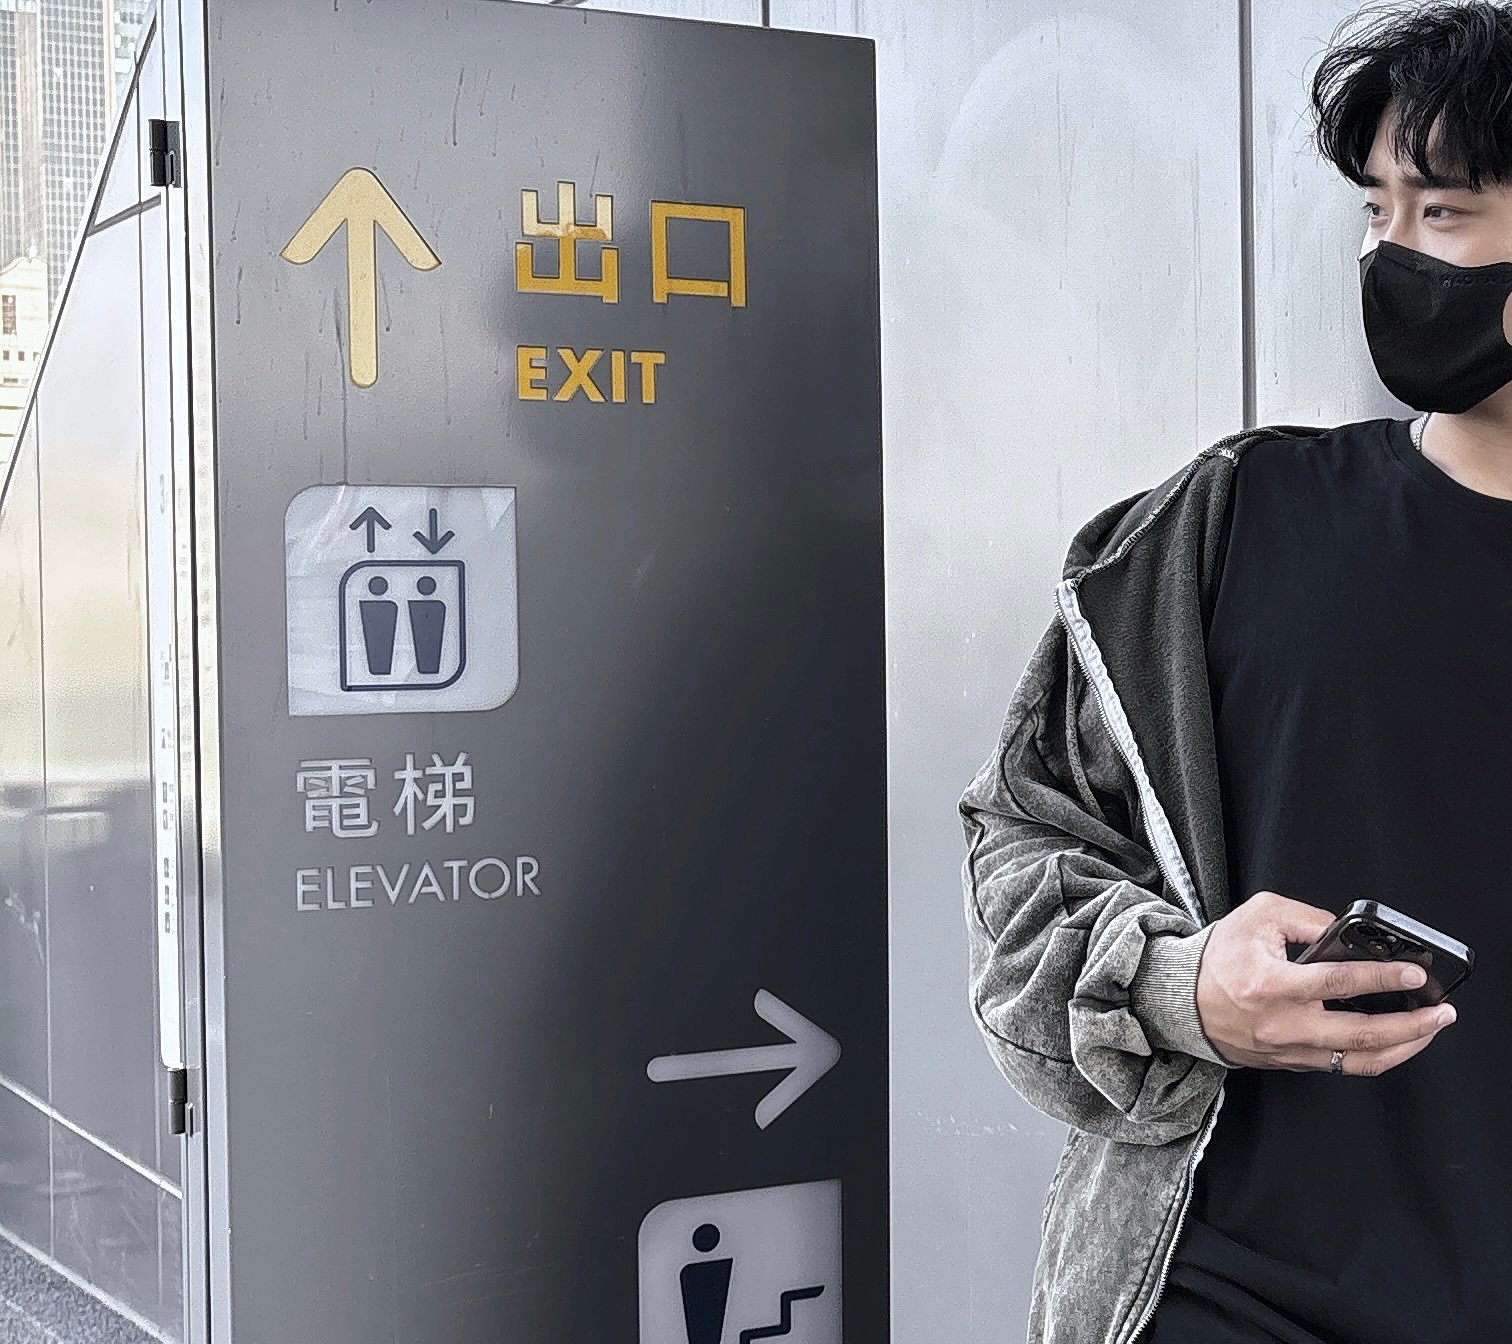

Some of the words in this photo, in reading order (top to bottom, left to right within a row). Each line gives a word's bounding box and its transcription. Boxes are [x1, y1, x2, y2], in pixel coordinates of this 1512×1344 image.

[515, 181, 747, 308] 出口
[516, 345, 666, 404] EXIT
[296, 752, 475, 838] 電梯
[297, 856, 541, 912] ELEVATOR
